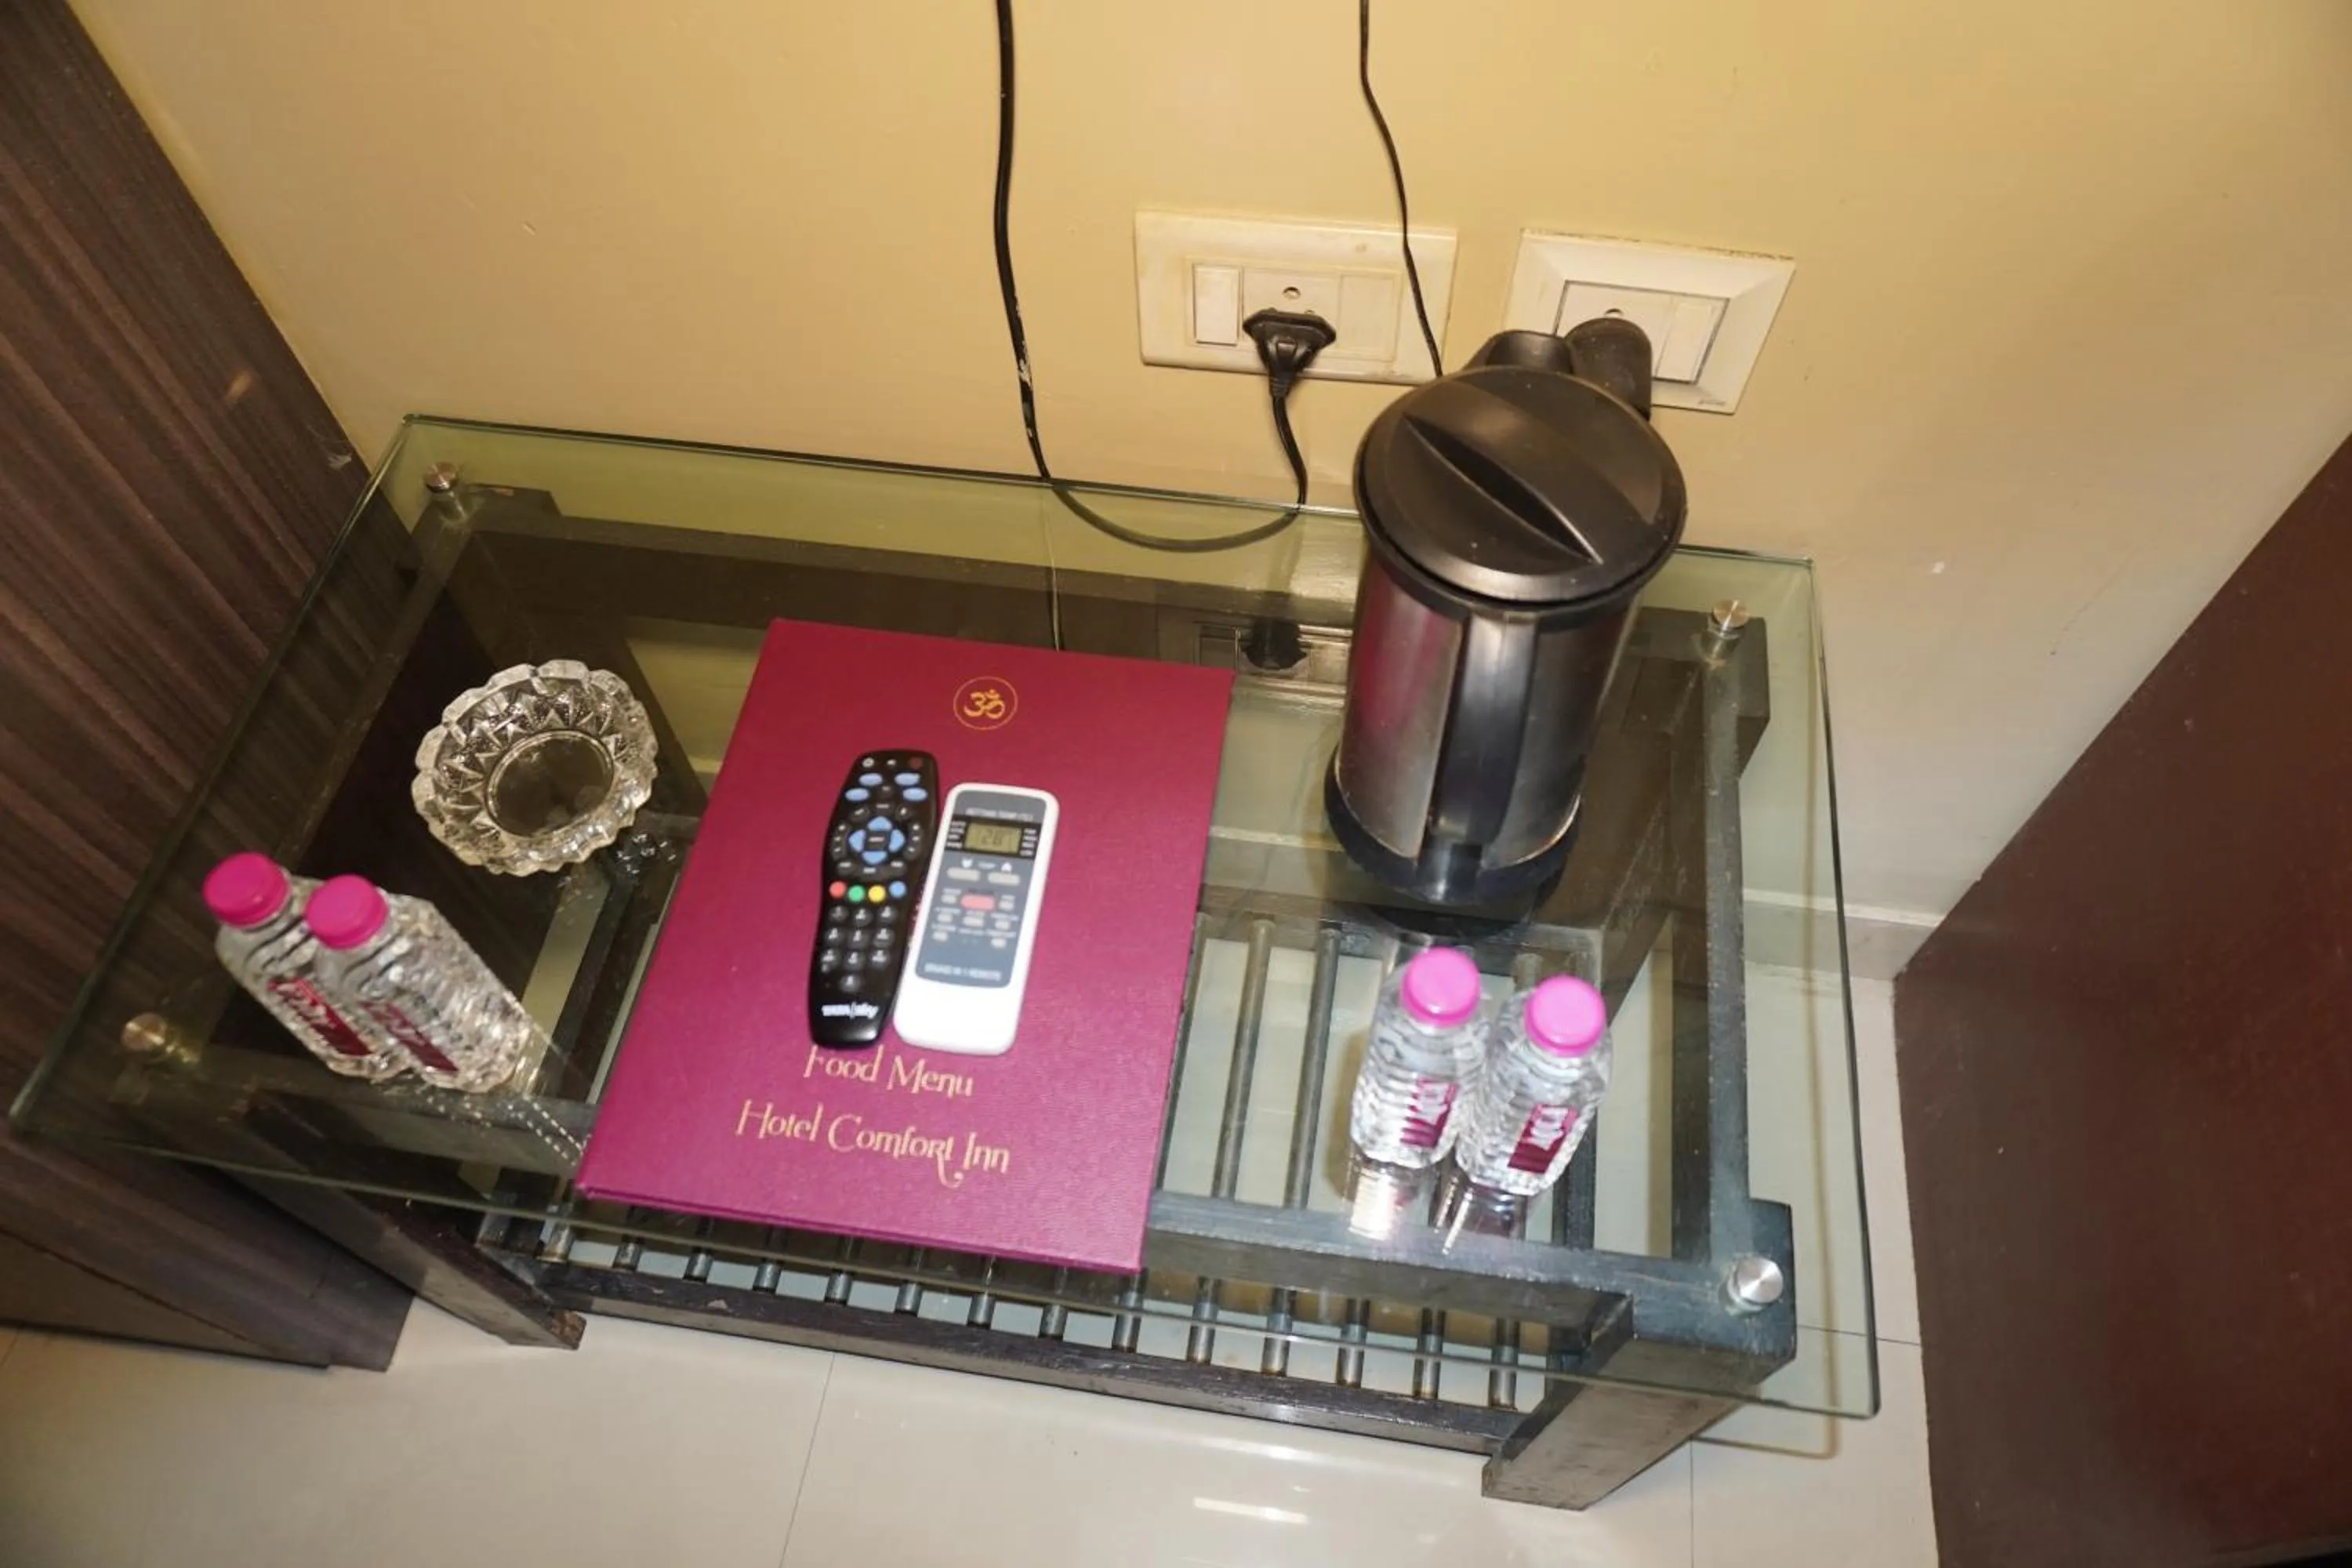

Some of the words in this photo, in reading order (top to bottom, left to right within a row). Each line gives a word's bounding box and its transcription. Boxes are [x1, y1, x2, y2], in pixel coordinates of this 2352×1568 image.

[803, 1044, 884, 1082] Food
[887, 1054, 973, 1098] Menu
[735, 1099, 823, 1142] Hotel
[828, 1113, 964, 1189] Comfort
[963, 1132, 1010, 1174] Inn
